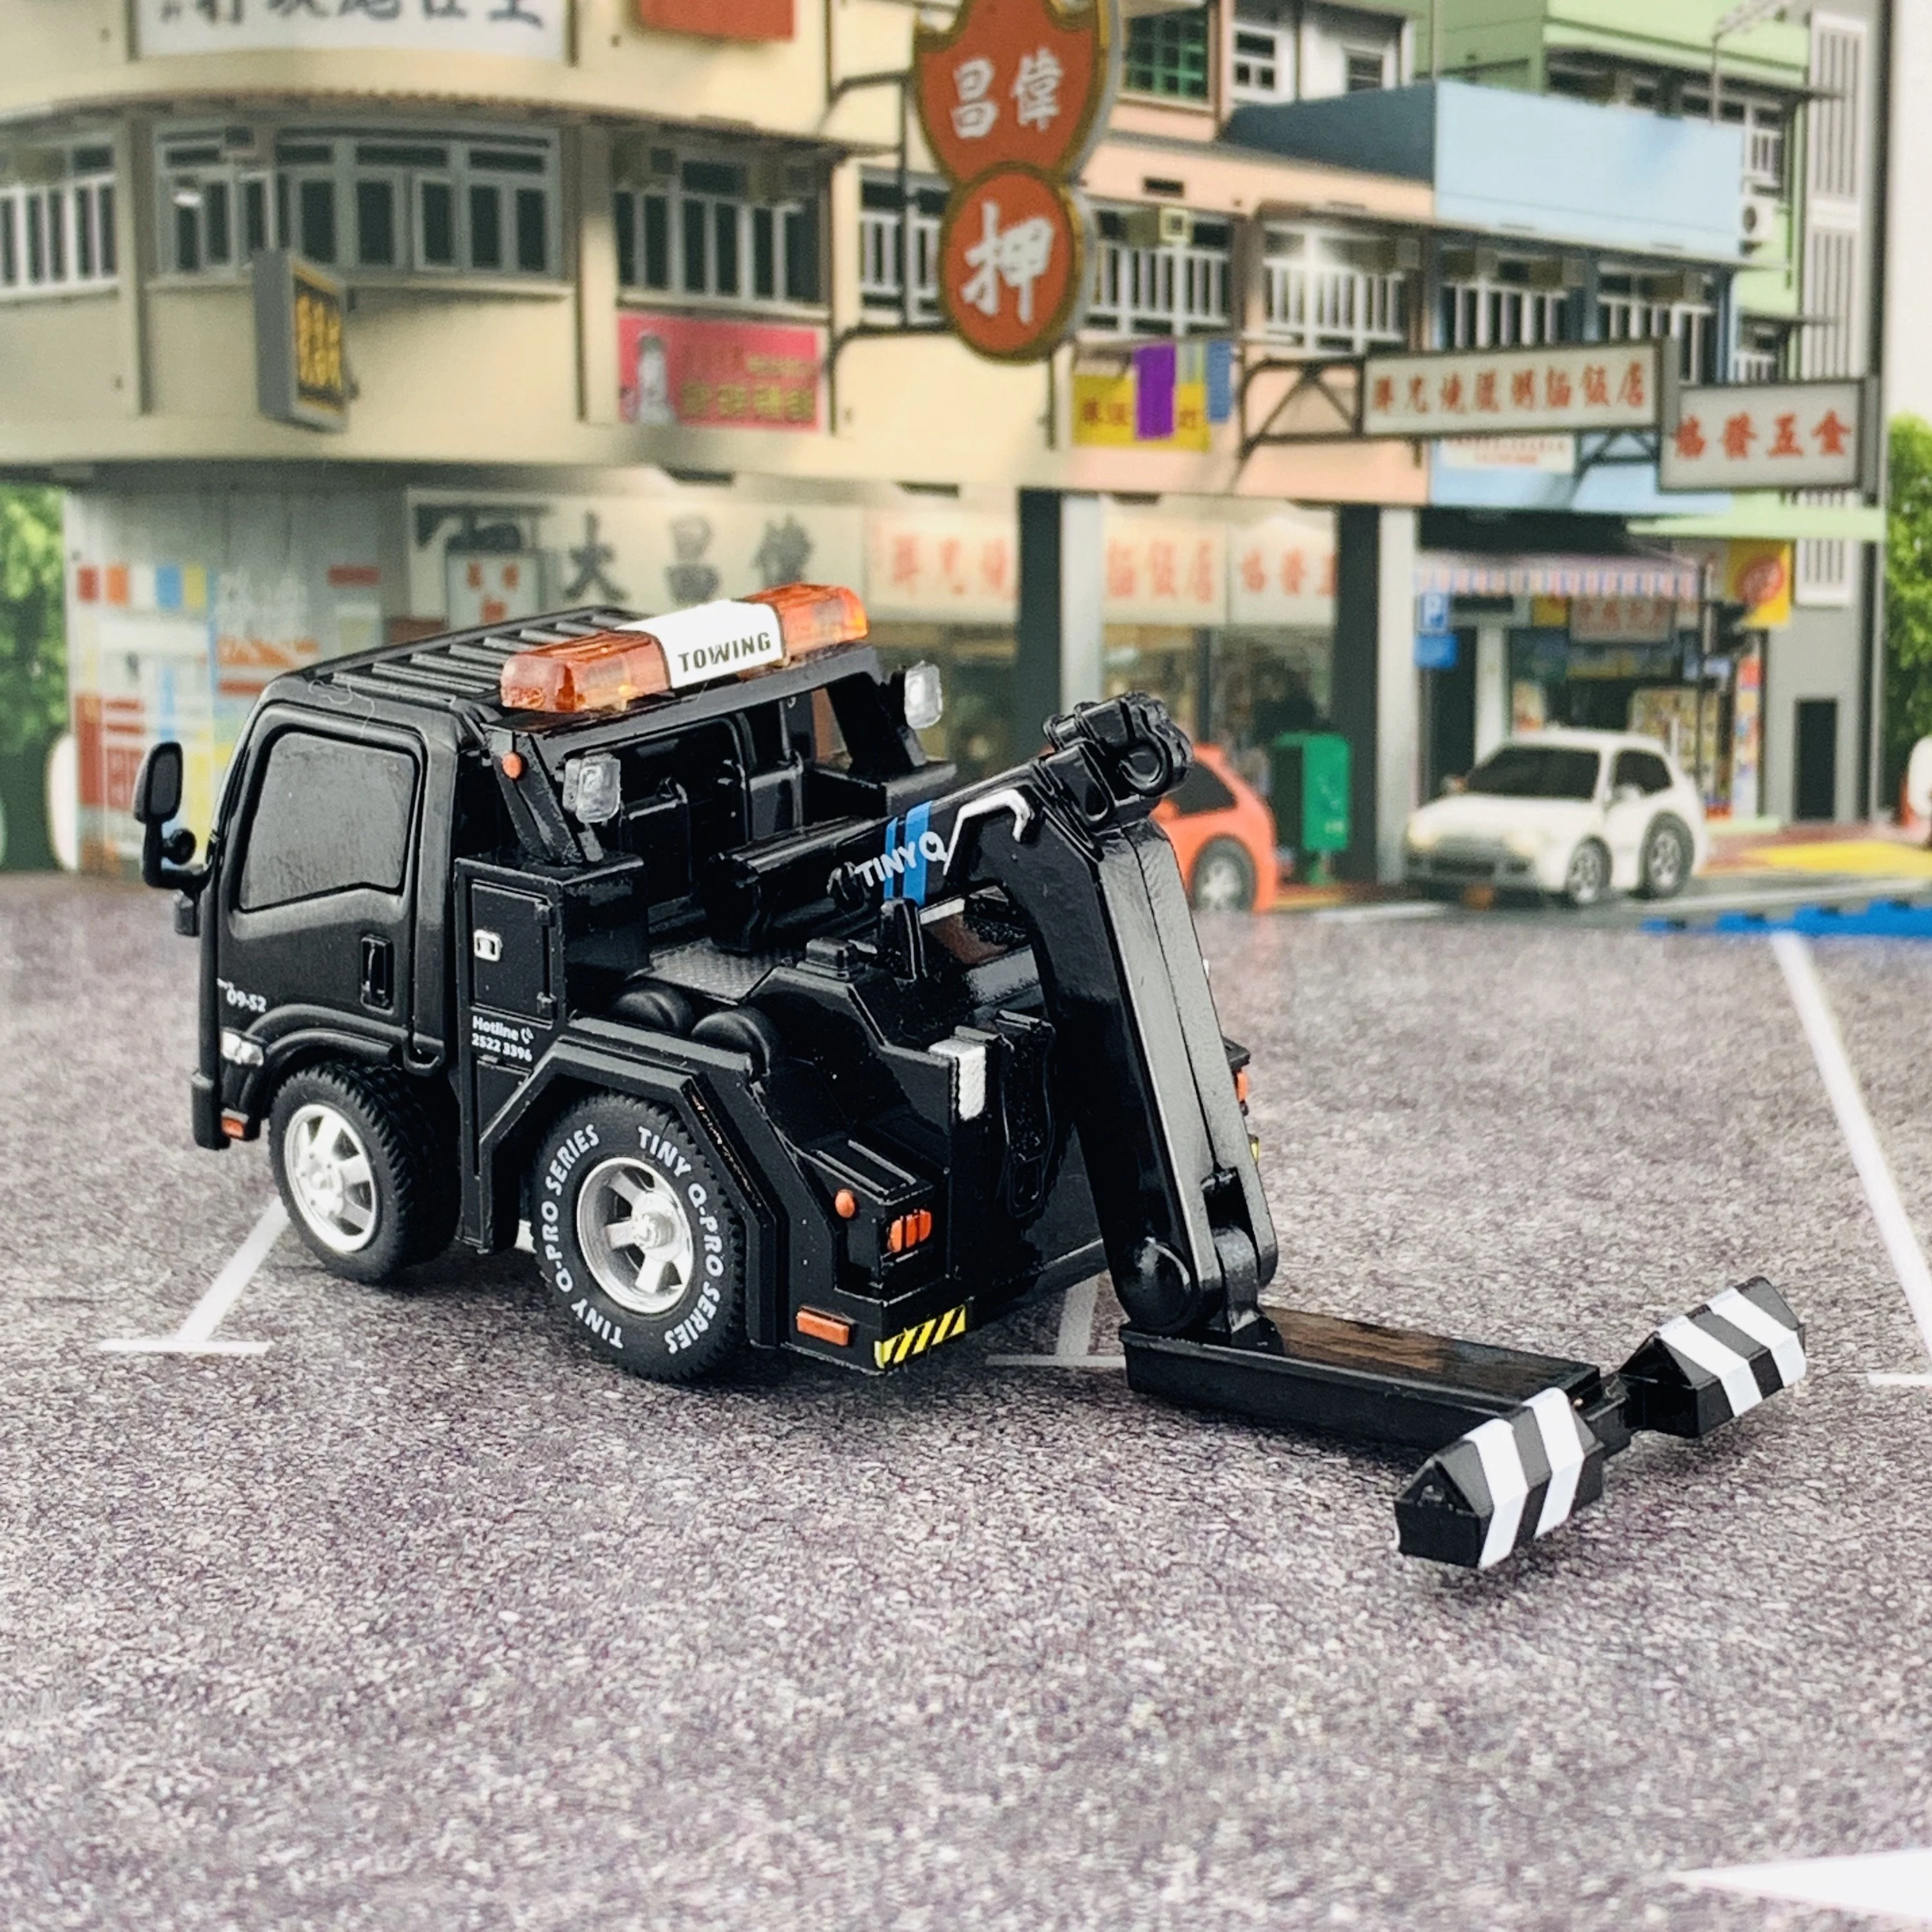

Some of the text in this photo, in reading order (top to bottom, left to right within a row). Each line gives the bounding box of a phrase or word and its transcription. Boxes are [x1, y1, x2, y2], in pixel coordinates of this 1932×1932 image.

[960, 201, 1055, 323] 押
[678, 632, 771, 673] TOWING
[471, 1032, 501, 1052] 2522
[473, 1015, 519, 1041] Hotline
[546, 1124, 599, 1195] SERIES
[638, 1126, 691, 1177] TINY
[571, 1298, 624, 1349] TINY
[664, 1281, 720, 1354] SERIES
